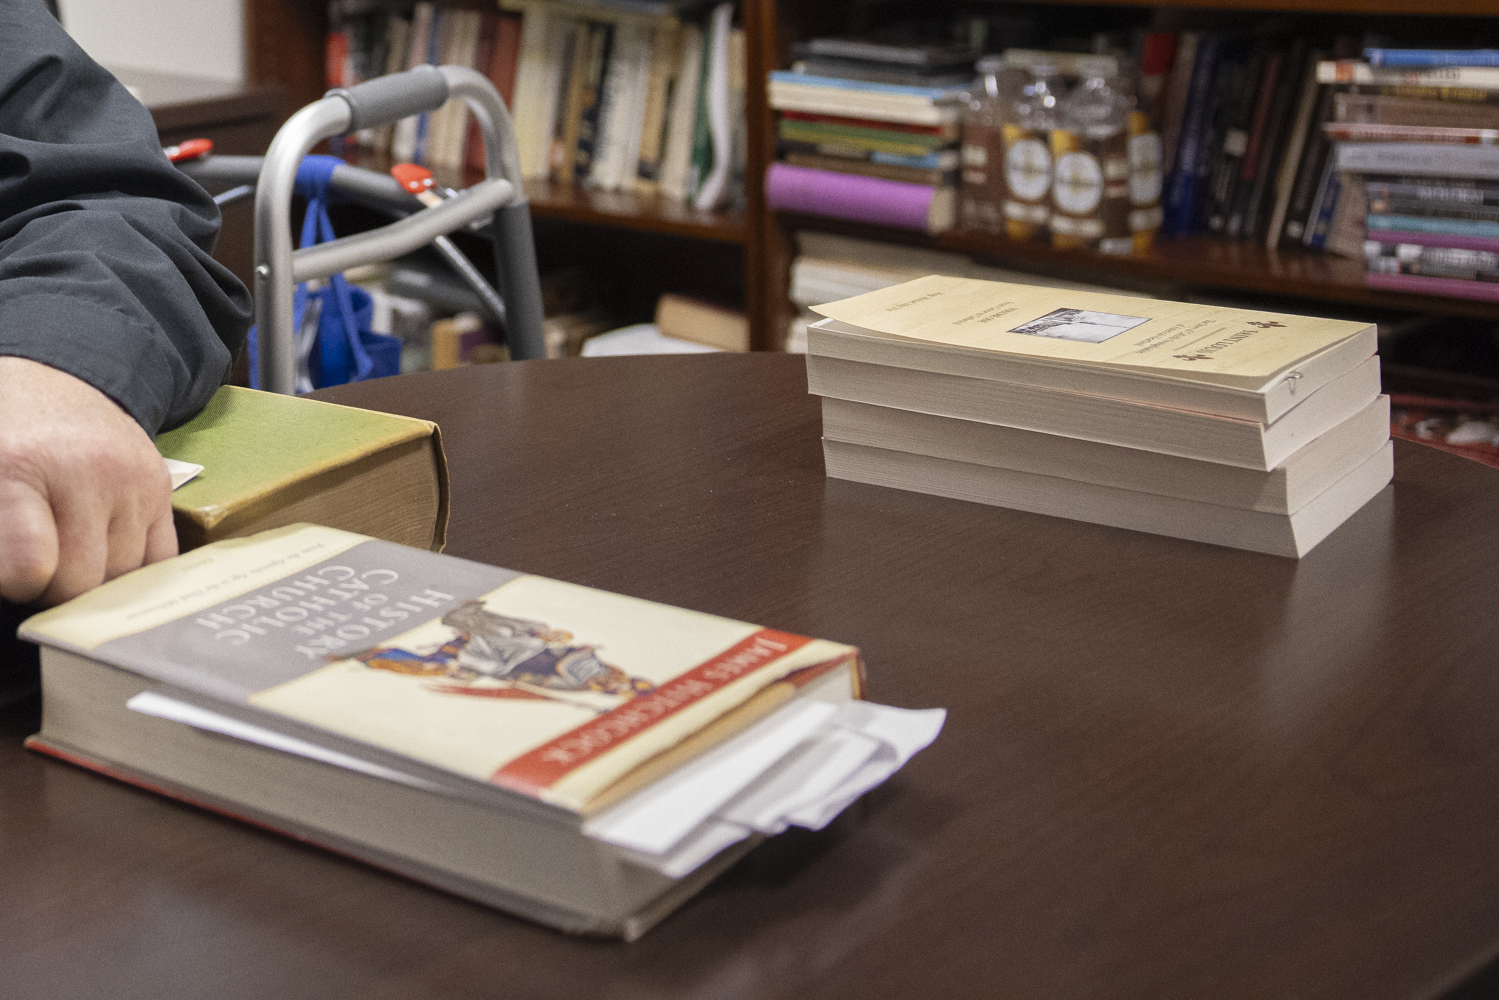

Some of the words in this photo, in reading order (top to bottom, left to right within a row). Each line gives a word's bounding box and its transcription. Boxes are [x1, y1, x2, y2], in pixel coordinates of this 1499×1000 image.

[189, 563, 365, 630] CHURCH
[206, 566, 408, 646] CATHOLIC
[285, 588, 459, 660] HISTORY
[286, 609, 357, 636] THE
[343, 591, 395, 611] OF
[693, 636, 793, 682] JAMES
[533, 677, 718, 767] HITCHCOCK
